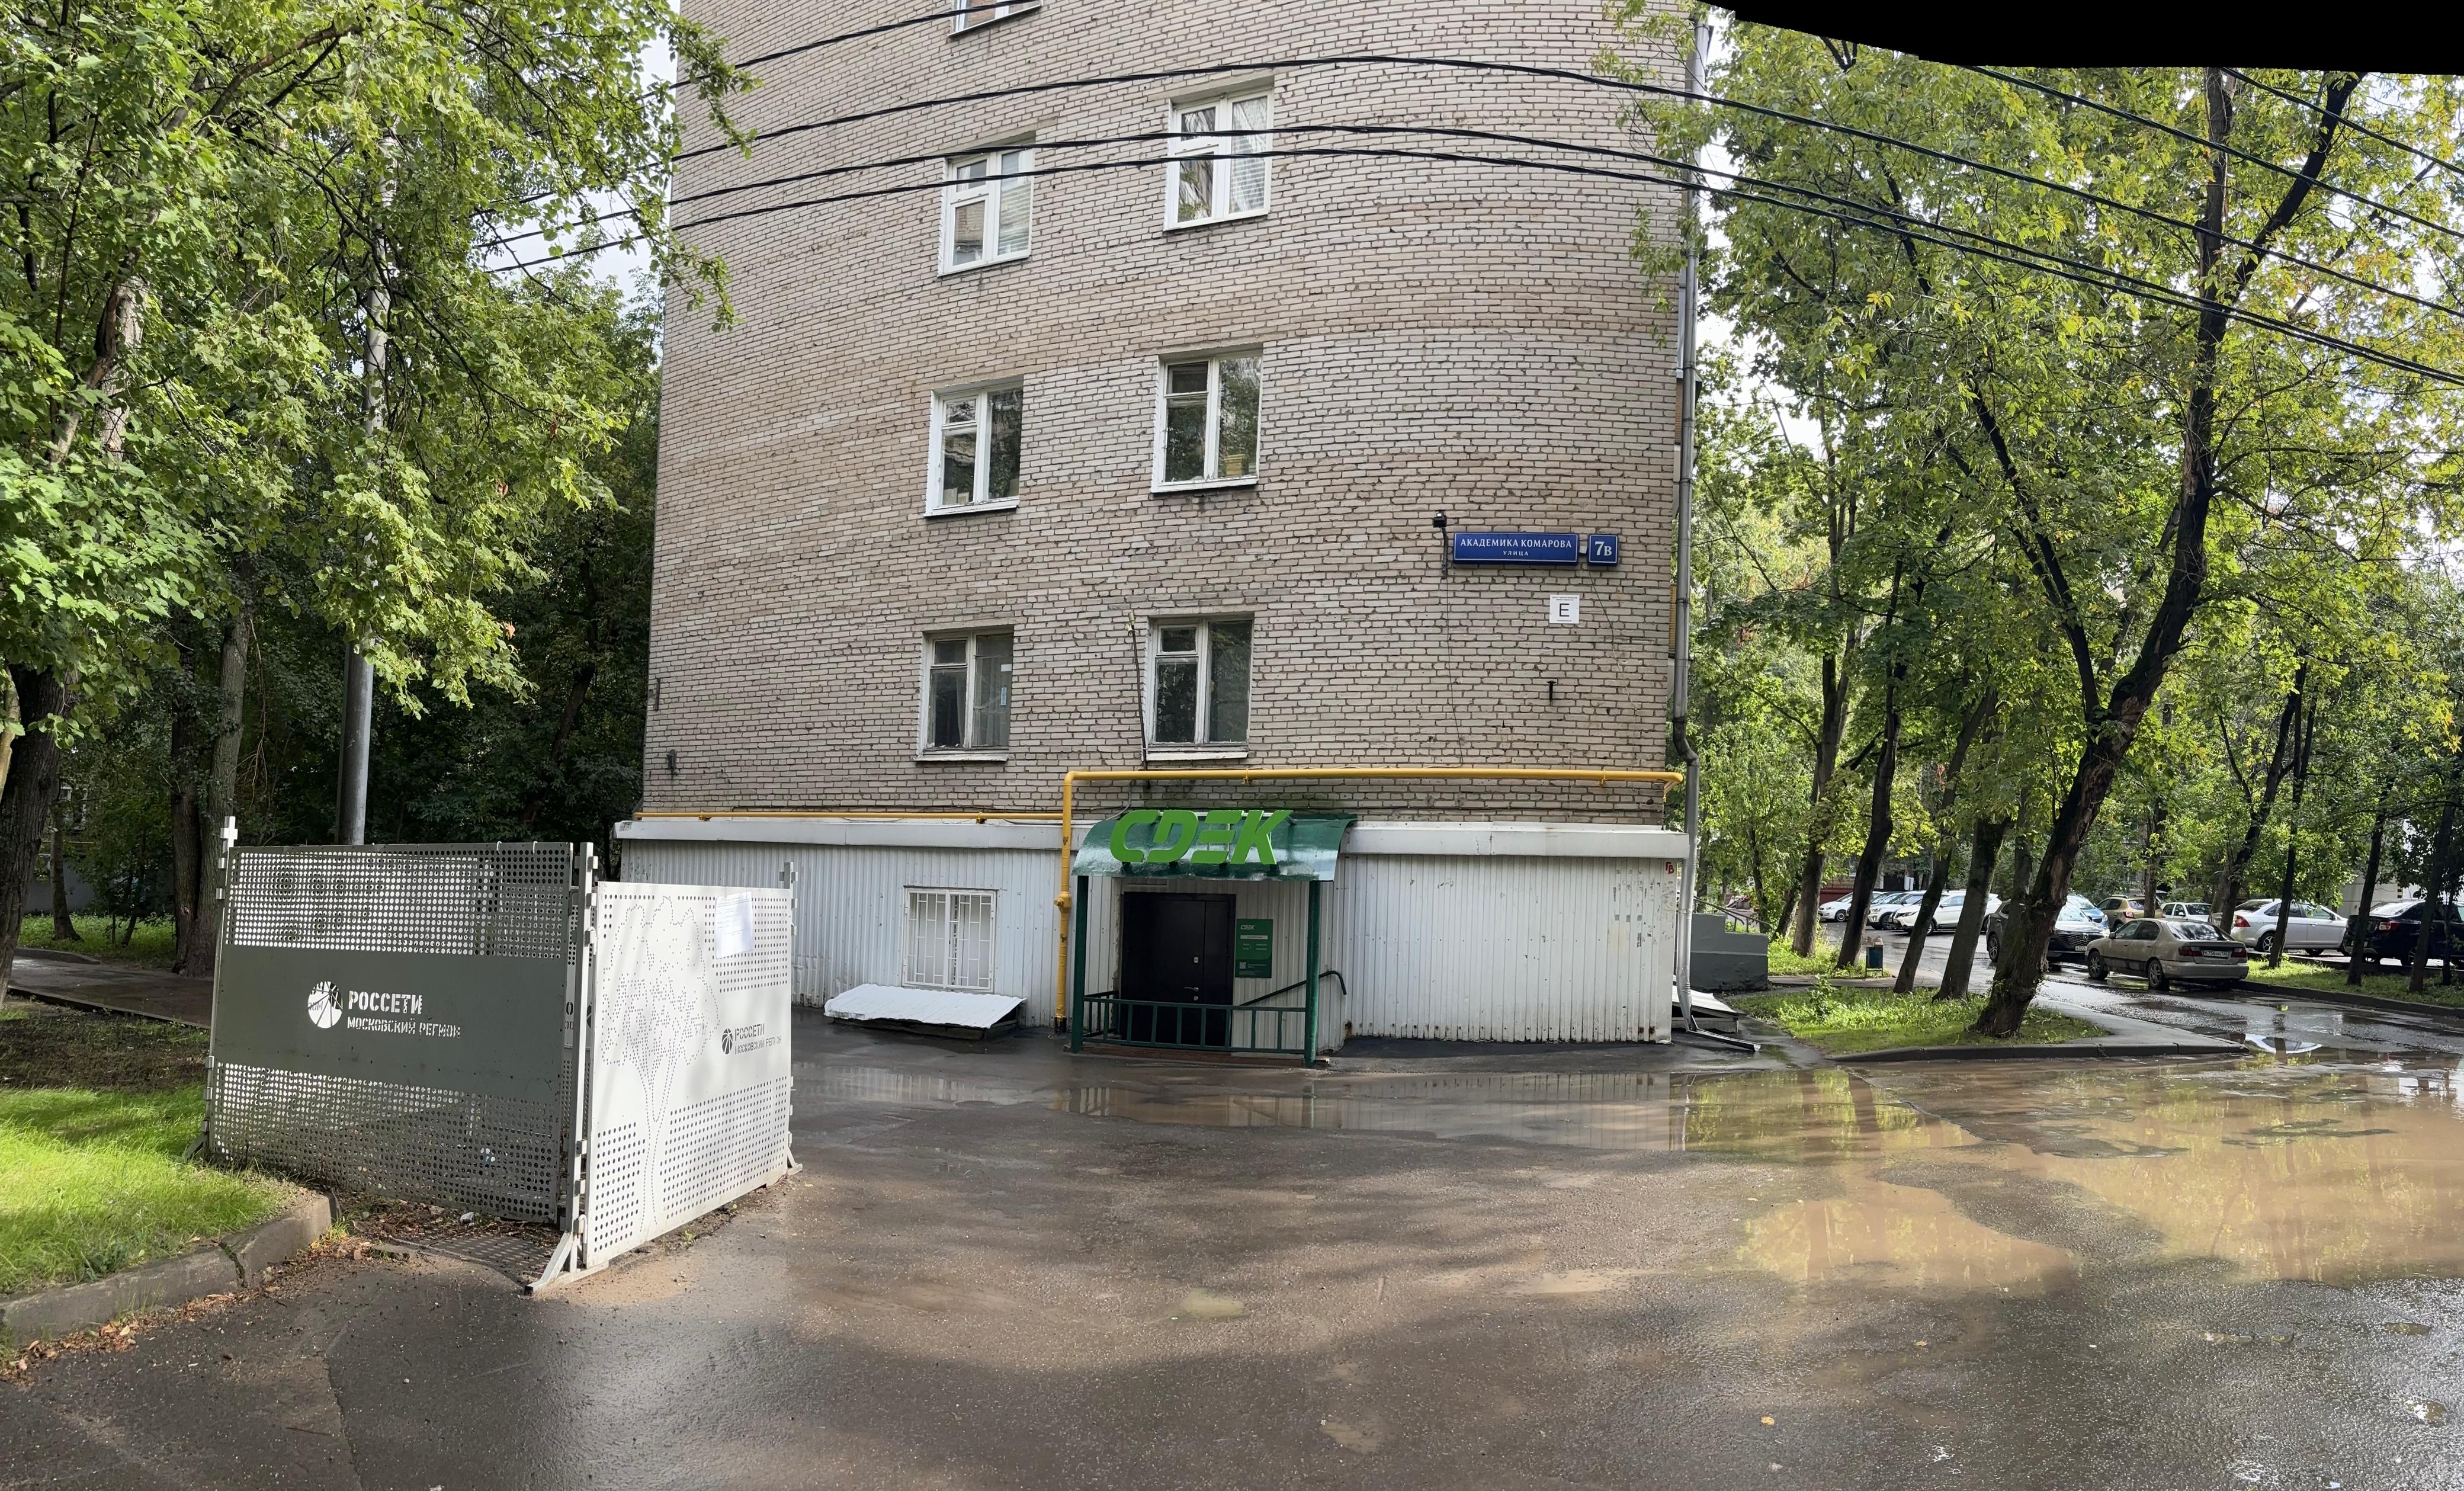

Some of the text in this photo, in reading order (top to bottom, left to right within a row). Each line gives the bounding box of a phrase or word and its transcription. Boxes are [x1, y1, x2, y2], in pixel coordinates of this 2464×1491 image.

[1460, 538, 1572, 548] АКАДЕМИКА КОМАРОВА
[1110, 810, 1294, 865] CDEK
[348, 990, 423, 1014] РОССЕТИ
[347, 1017, 461, 1038] МОСКОВСКИЙ РЕГИОН
[734, 1023, 765, 1041] РОССЕТИ
[734, 1038, 765, 1054] МОСКОВСКИЙ
